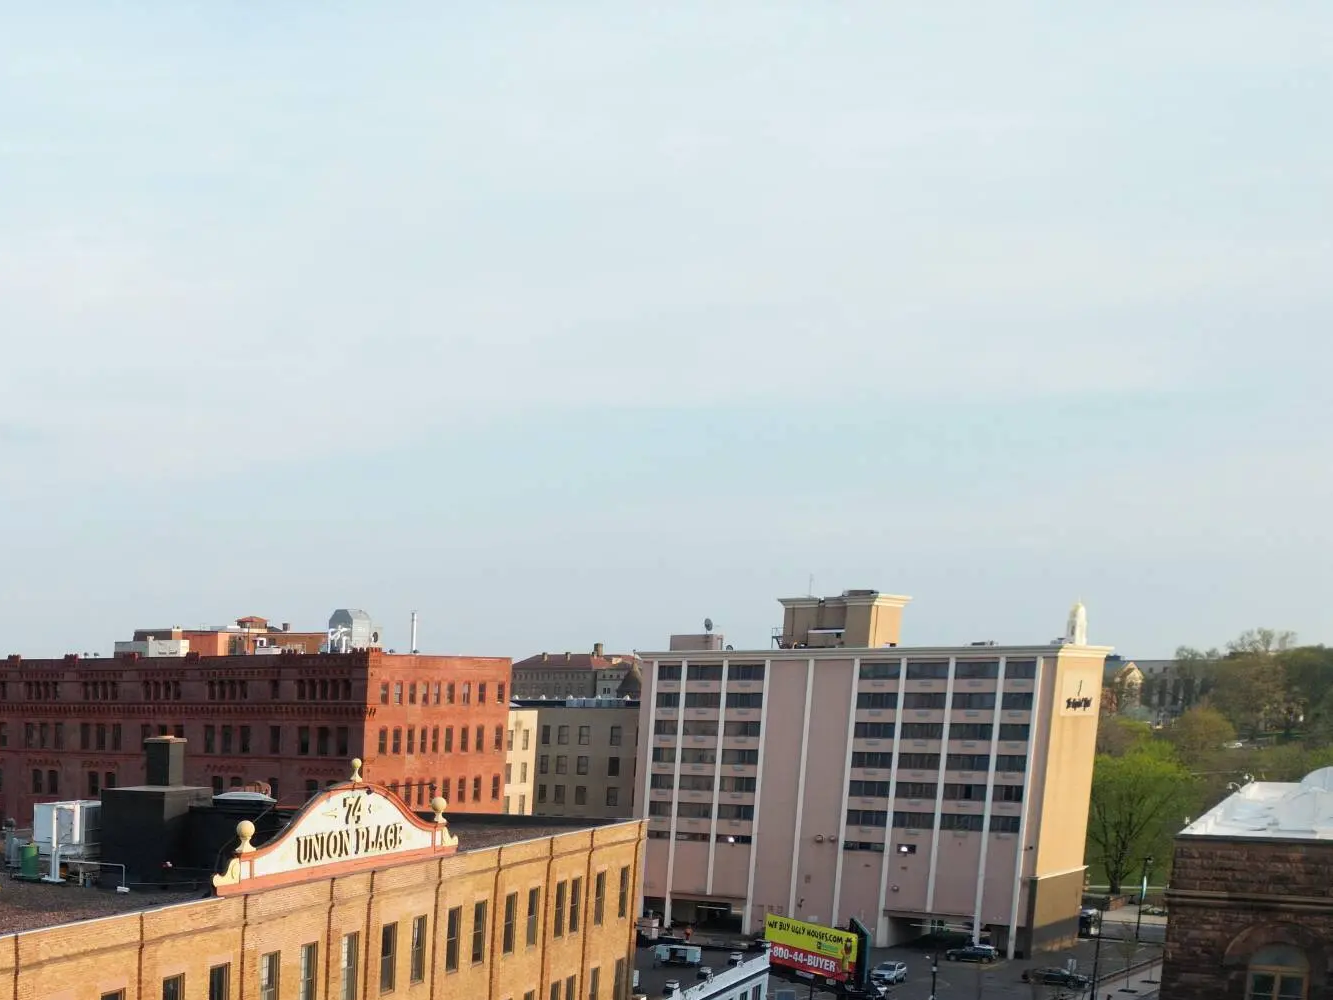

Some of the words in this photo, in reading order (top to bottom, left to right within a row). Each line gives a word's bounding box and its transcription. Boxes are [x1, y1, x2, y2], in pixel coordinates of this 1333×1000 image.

[343, 796, 362, 825] 74
[296, 830, 350, 865] UNION
[355, 822, 403, 854] PLACE
[768, 920, 777, 929] WE
[778, 921, 790, 931] BUY
[791, 924, 806, 935] UGLY
[770, 945, 836, 973] -800-44-BUYER
